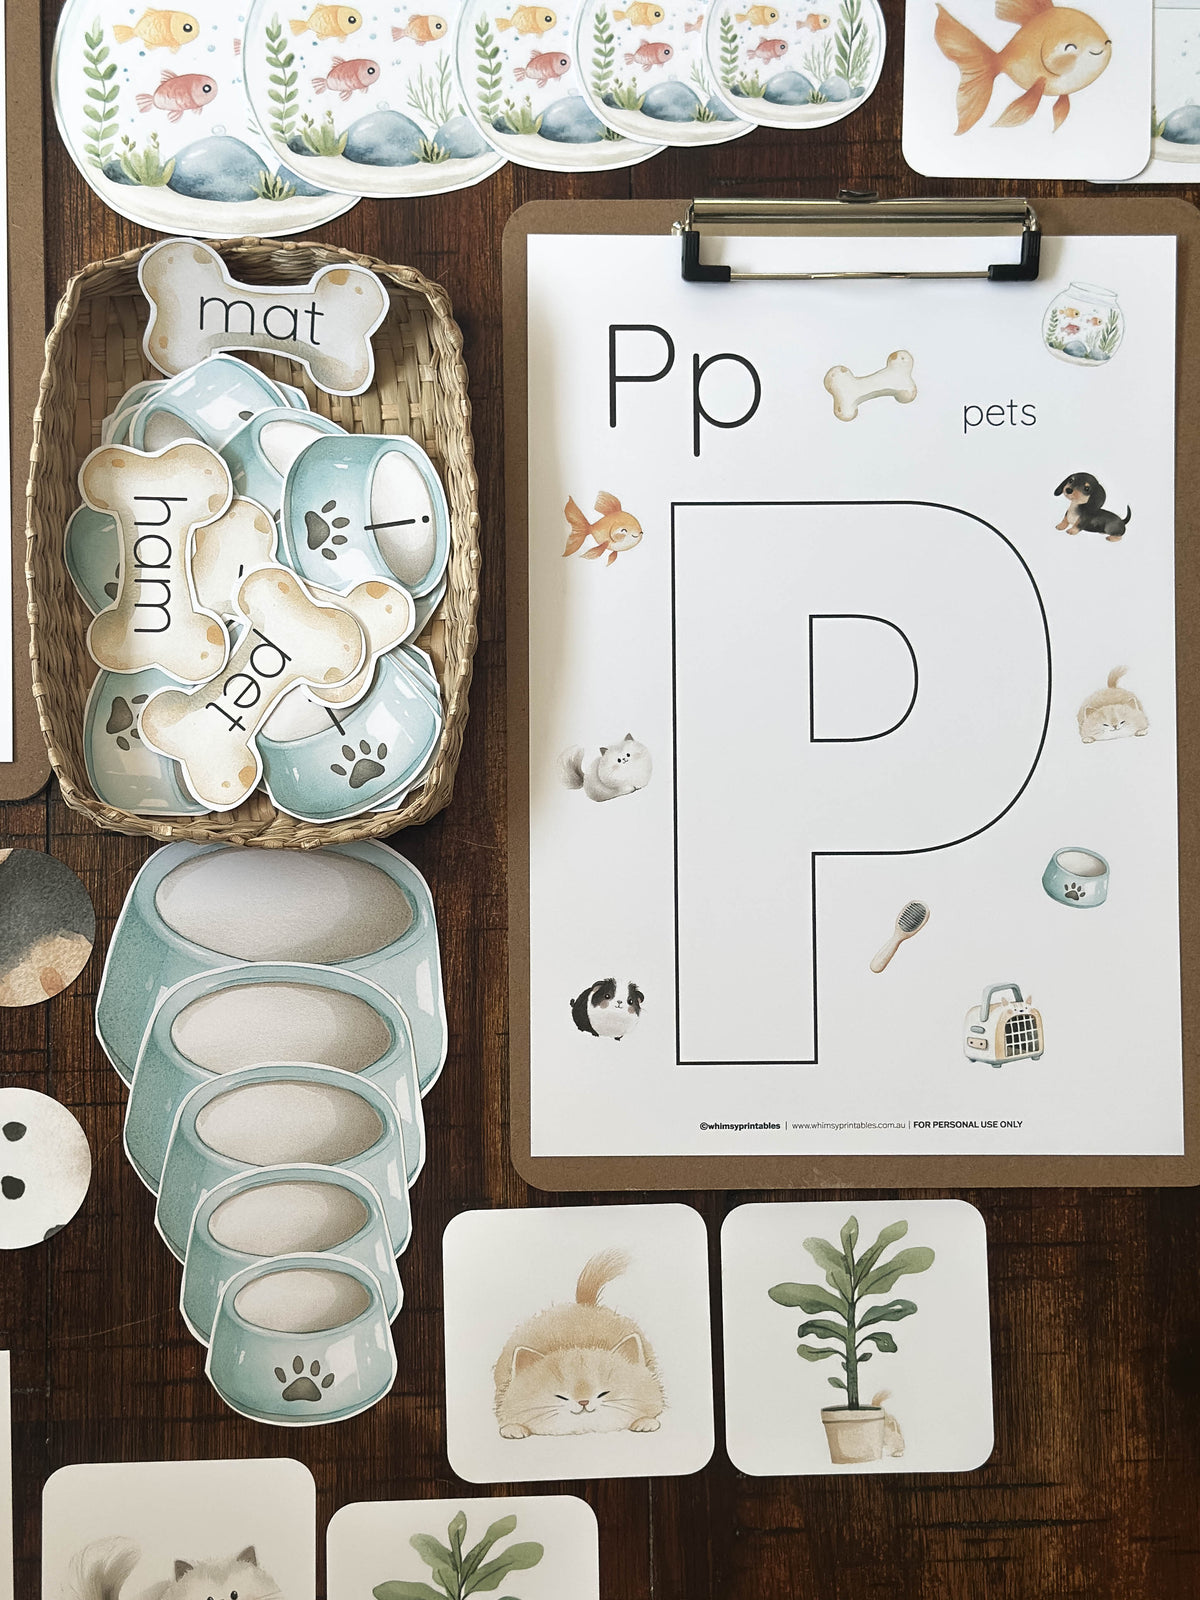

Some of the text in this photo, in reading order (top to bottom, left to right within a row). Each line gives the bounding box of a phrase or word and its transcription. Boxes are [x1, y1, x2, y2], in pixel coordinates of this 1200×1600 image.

[199, 295, 323, 345] mat
[609, 325, 761, 457] Pp
[963, 399, 1037, 434] pets
[134, 496, 188, 632] ham
[206, 628, 292, 733] pet
[671, 501, 1051, 1065] P
[699, 1120, 1023, 1131] ©whimsyprintables www.whimsyprintables.com.au FOR PERSONAL USE ONLY
